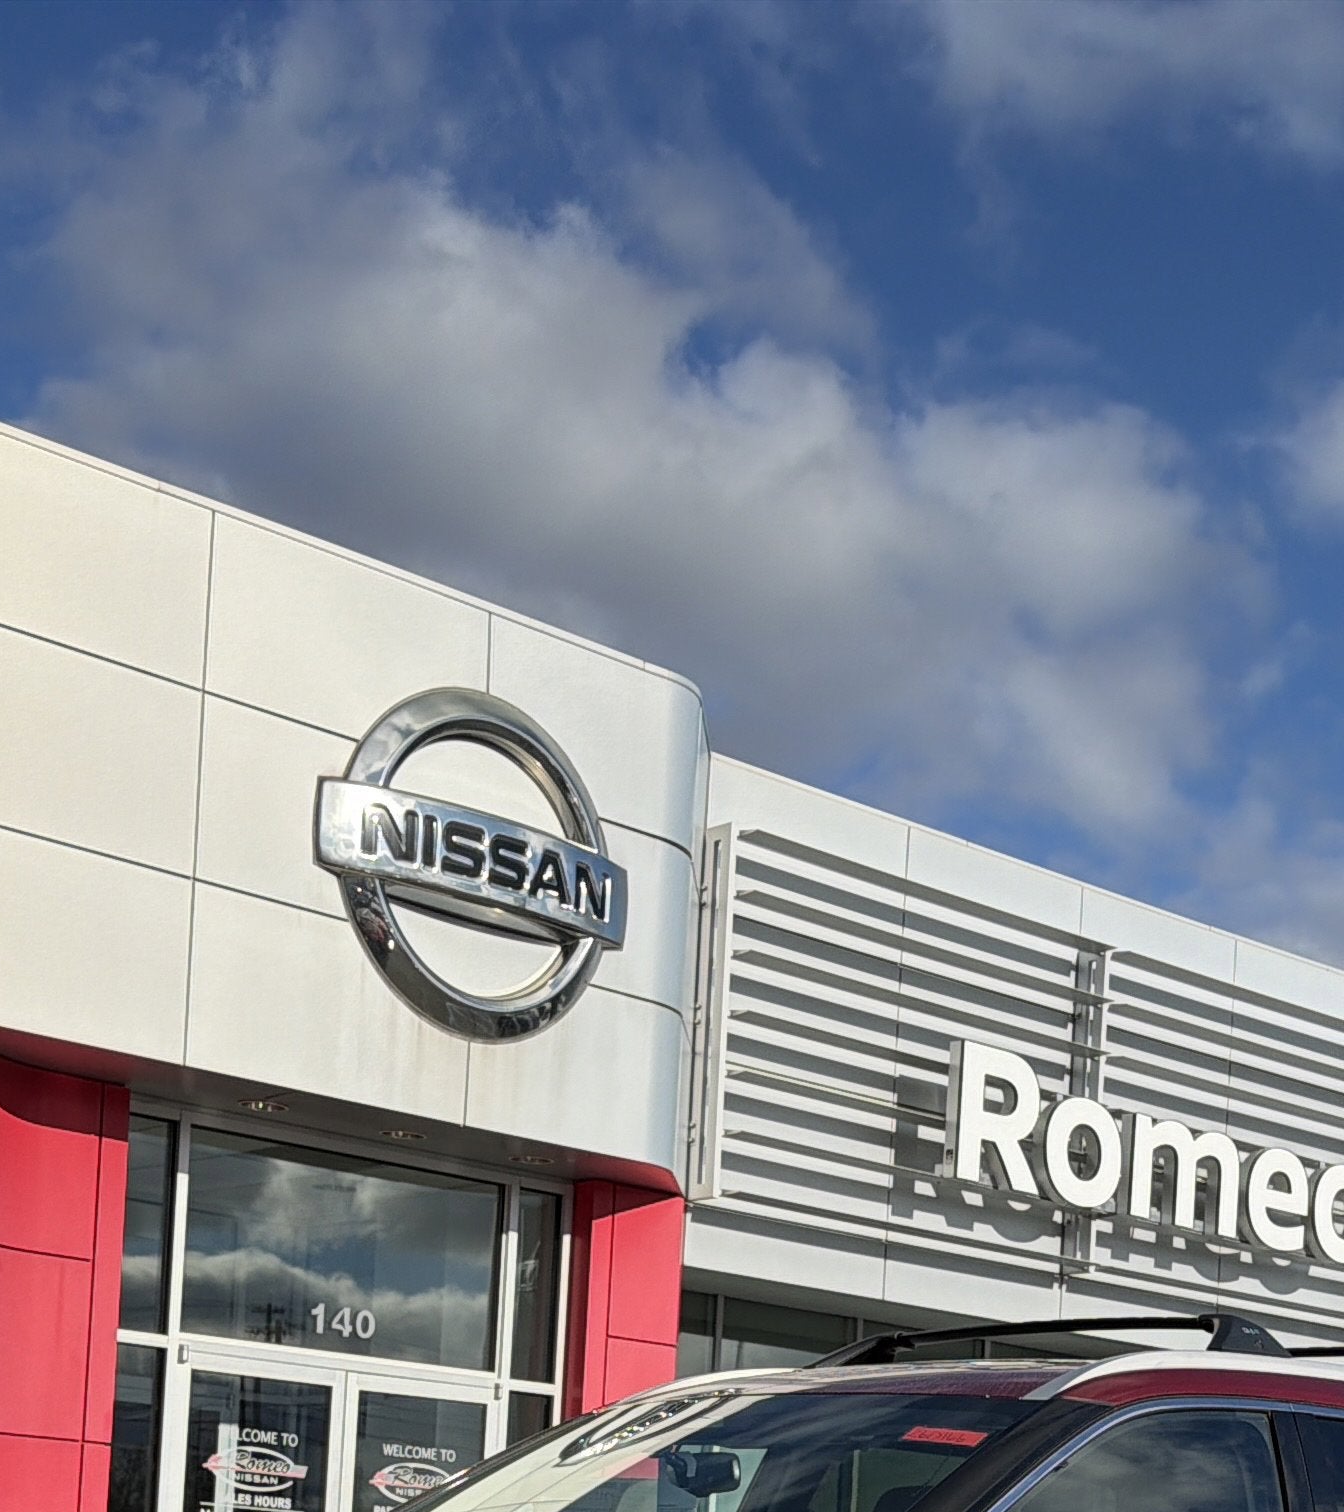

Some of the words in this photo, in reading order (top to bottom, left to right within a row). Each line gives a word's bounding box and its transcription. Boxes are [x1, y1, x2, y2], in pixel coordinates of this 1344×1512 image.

[360, 802, 612, 923] NISSAN
[311, 1303, 376, 1339] 140
[229, 1427, 278, 1446] LCOME
[281, 1433, 299, 1448] TO
[232, 1451, 292, 1474] Romeo
[382, 1443, 438, 1461] WELCOME
[440, 1448, 456, 1463] TO
[391, 1466, 445, 1488] Rome
[254, 1495, 292, 1510] HOURS
